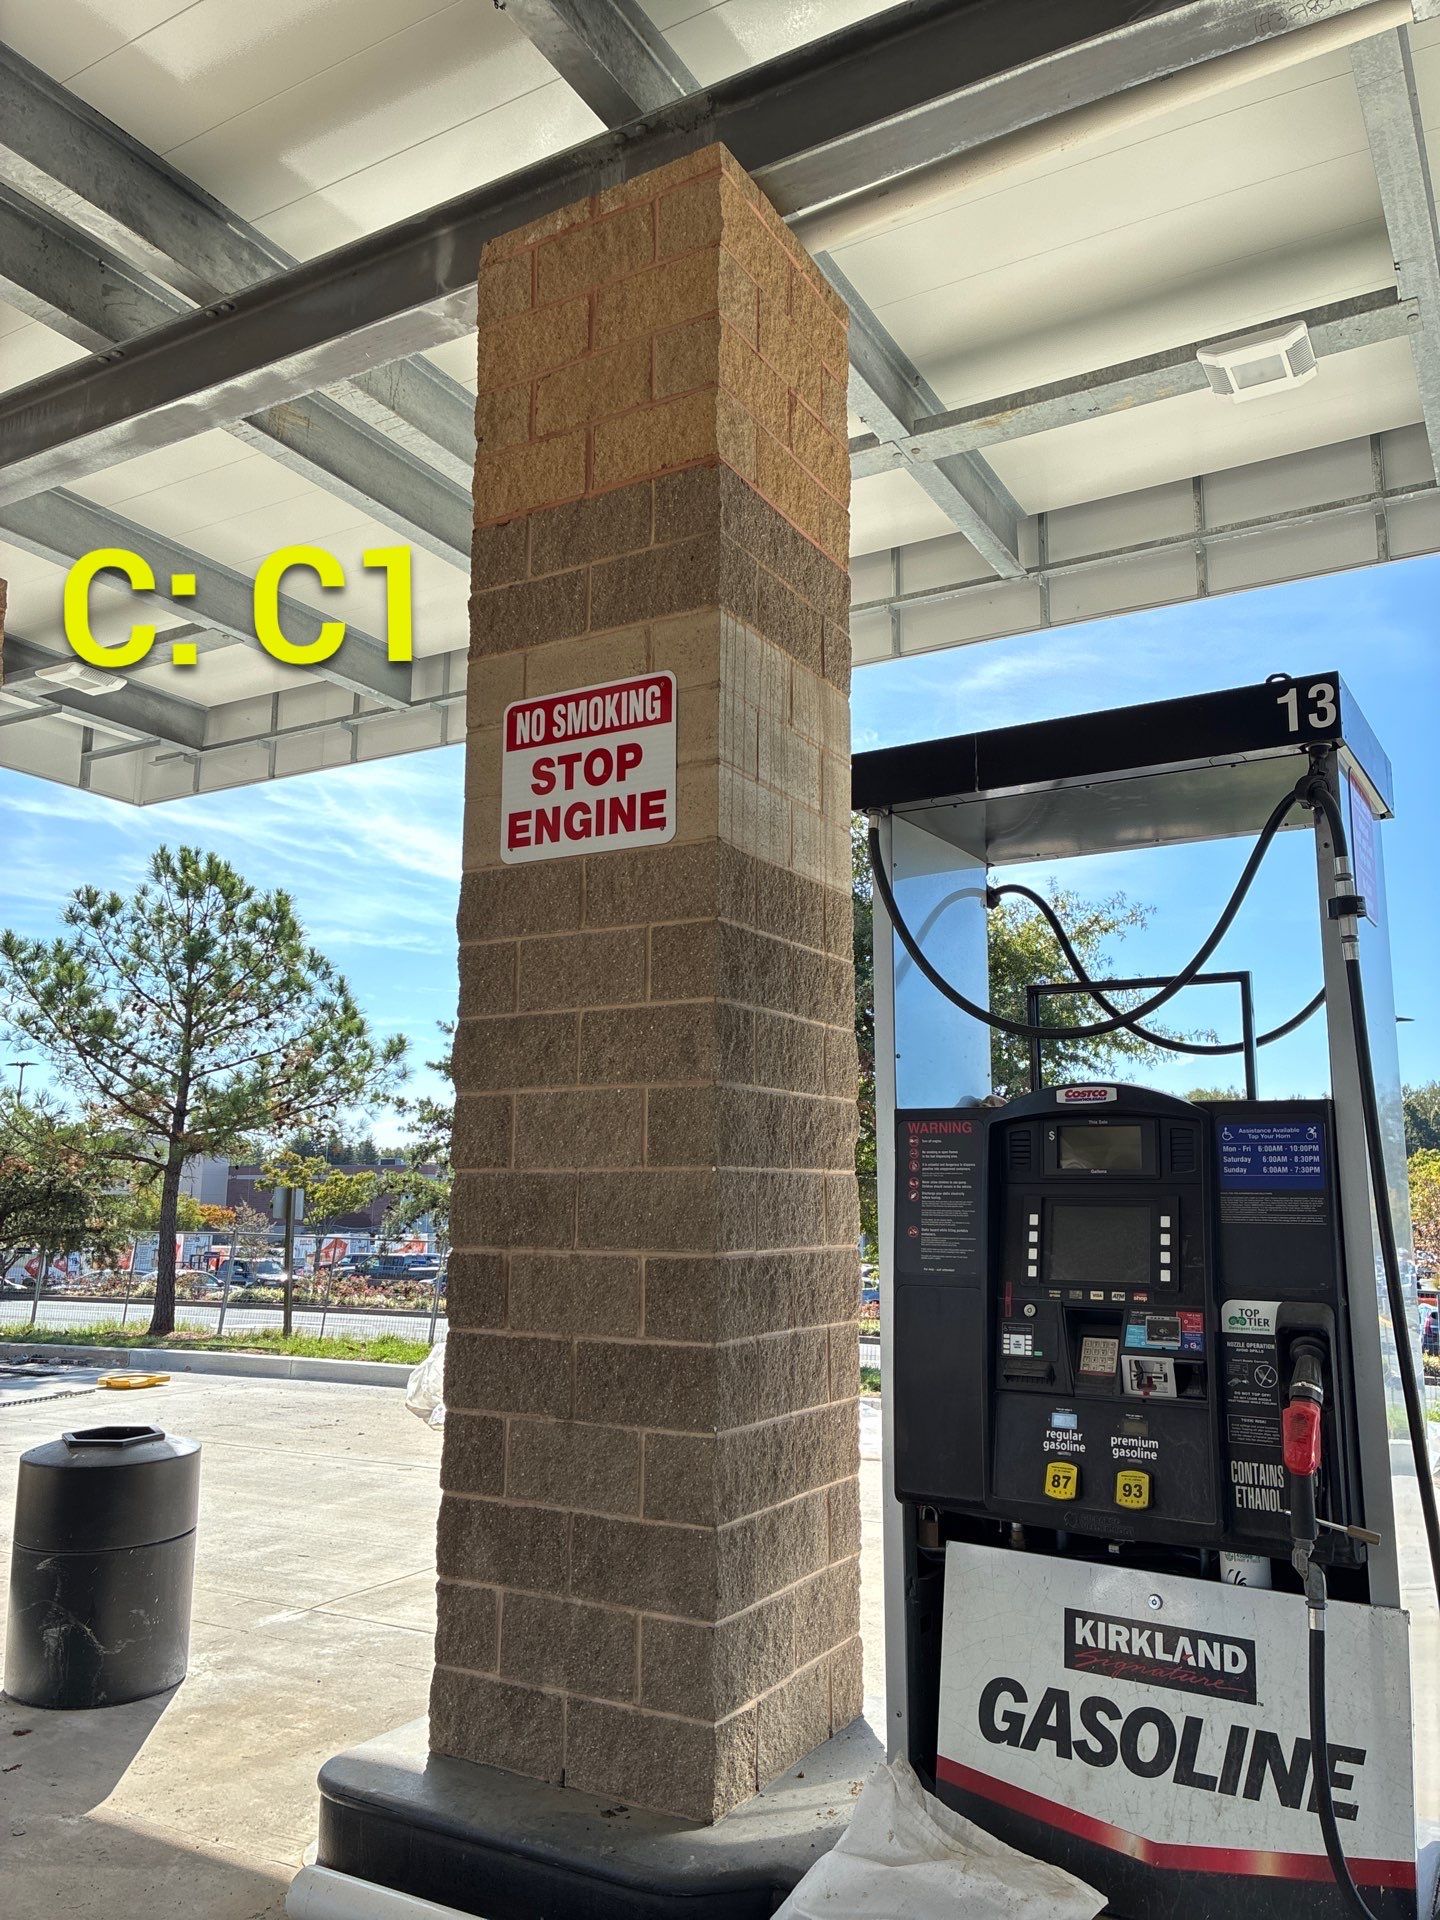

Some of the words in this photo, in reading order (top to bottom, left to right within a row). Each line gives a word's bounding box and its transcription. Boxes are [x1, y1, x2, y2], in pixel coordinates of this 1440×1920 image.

[516, 708, 545, 745] NO
[552, 684, 661, 738] SMOKING
[1277, 683, 1337, 732] 13
[531, 742, 643, 795] STOP
[507, 789, 667, 849] ENGINE
[1065, 1089, 1108, 1098] COSTCO
[908, 1121, 972, 1133] WARNING
[1048, 1130, 1055, 1141] $
[1262, 1166, 1288, 1174] 6:00AM
[1239, 1308, 1260, 1317] TOP
[1247, 1318, 1270, 1327] TIER
[1046, 1429, 1083, 1442] regular
[1110, 1436, 1159, 1449] premium
[1043, 1440, 1086, 1453] gasoline
[1112, 1447, 1158, 1460] gasoline
[1051, 1474, 1072, 1489] 87
[1230, 1460, 1284, 1488] CONTAINS
[1122, 1483, 1143, 1498] 93
[1235, 1485, 1284, 1513] ETHANOL
[1075, 1617, 1248, 1674] KIRKLAND
[1074, 1649, 1248, 1692] Signature
[978, 1676, 1367, 1821] GASOLINE
